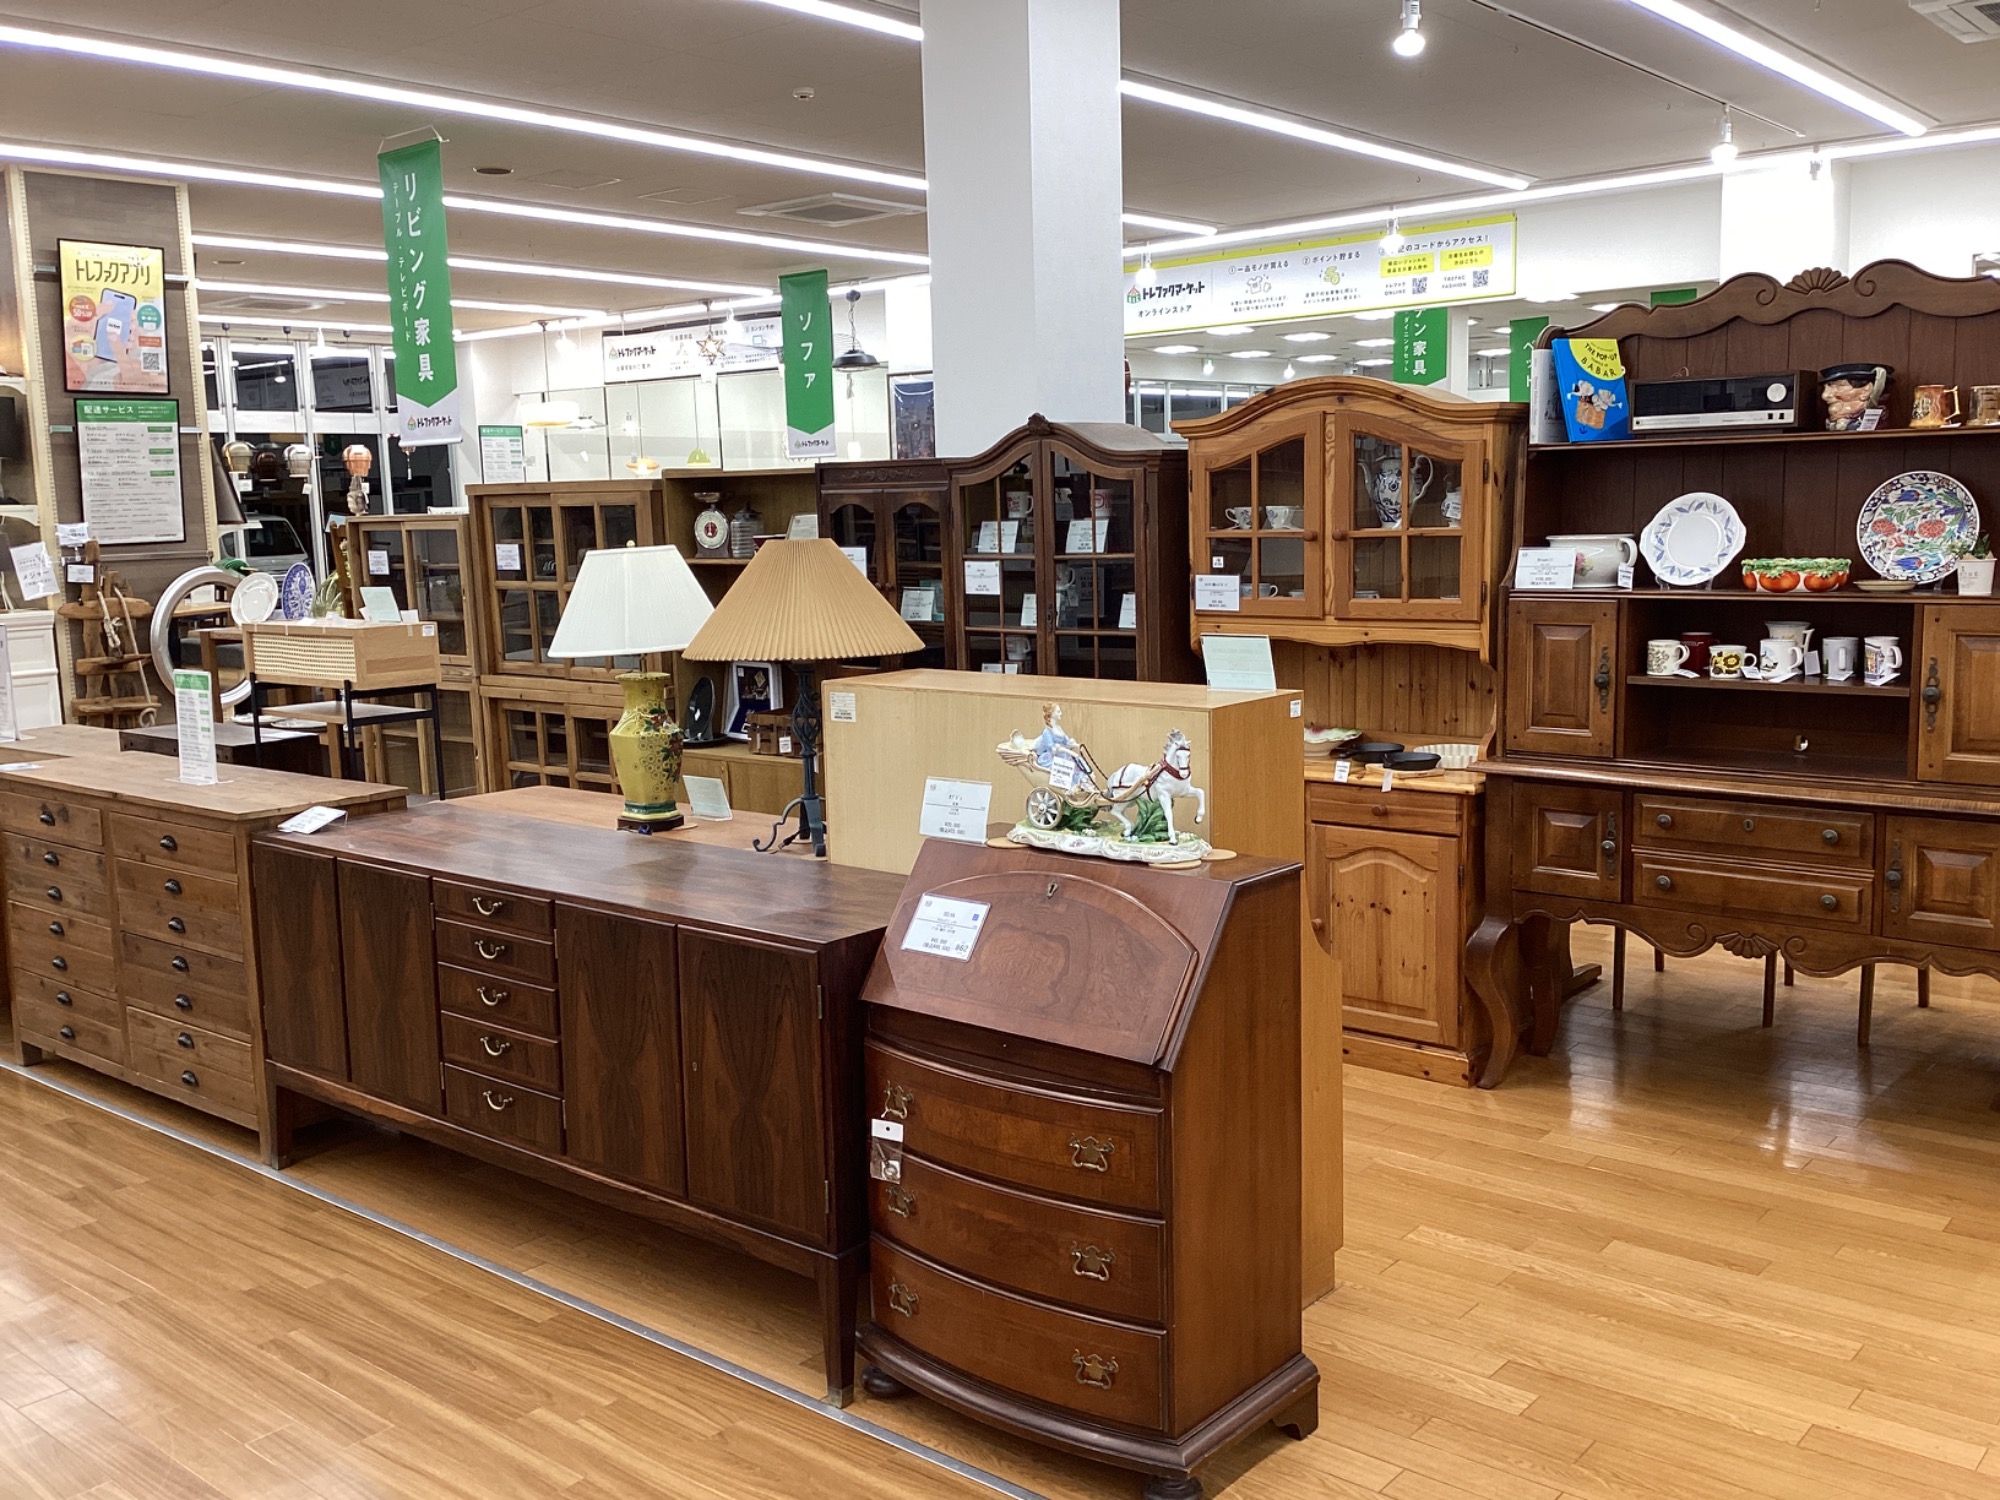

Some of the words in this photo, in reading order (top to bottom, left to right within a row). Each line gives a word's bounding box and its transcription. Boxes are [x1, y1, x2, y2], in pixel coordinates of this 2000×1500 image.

[75, 259, 151, 287] トレファクアプリ
[393, 182, 410, 342] テーブル・テレビボード
[404, 172, 434, 382] リビング家具
[1138, 304, 1193, 318] オンラインストア
[800, 311, 816, 390] ソファ
[1580, 356, 1617, 378] BABAR
[83, 405, 134, 415] 配送サービス
